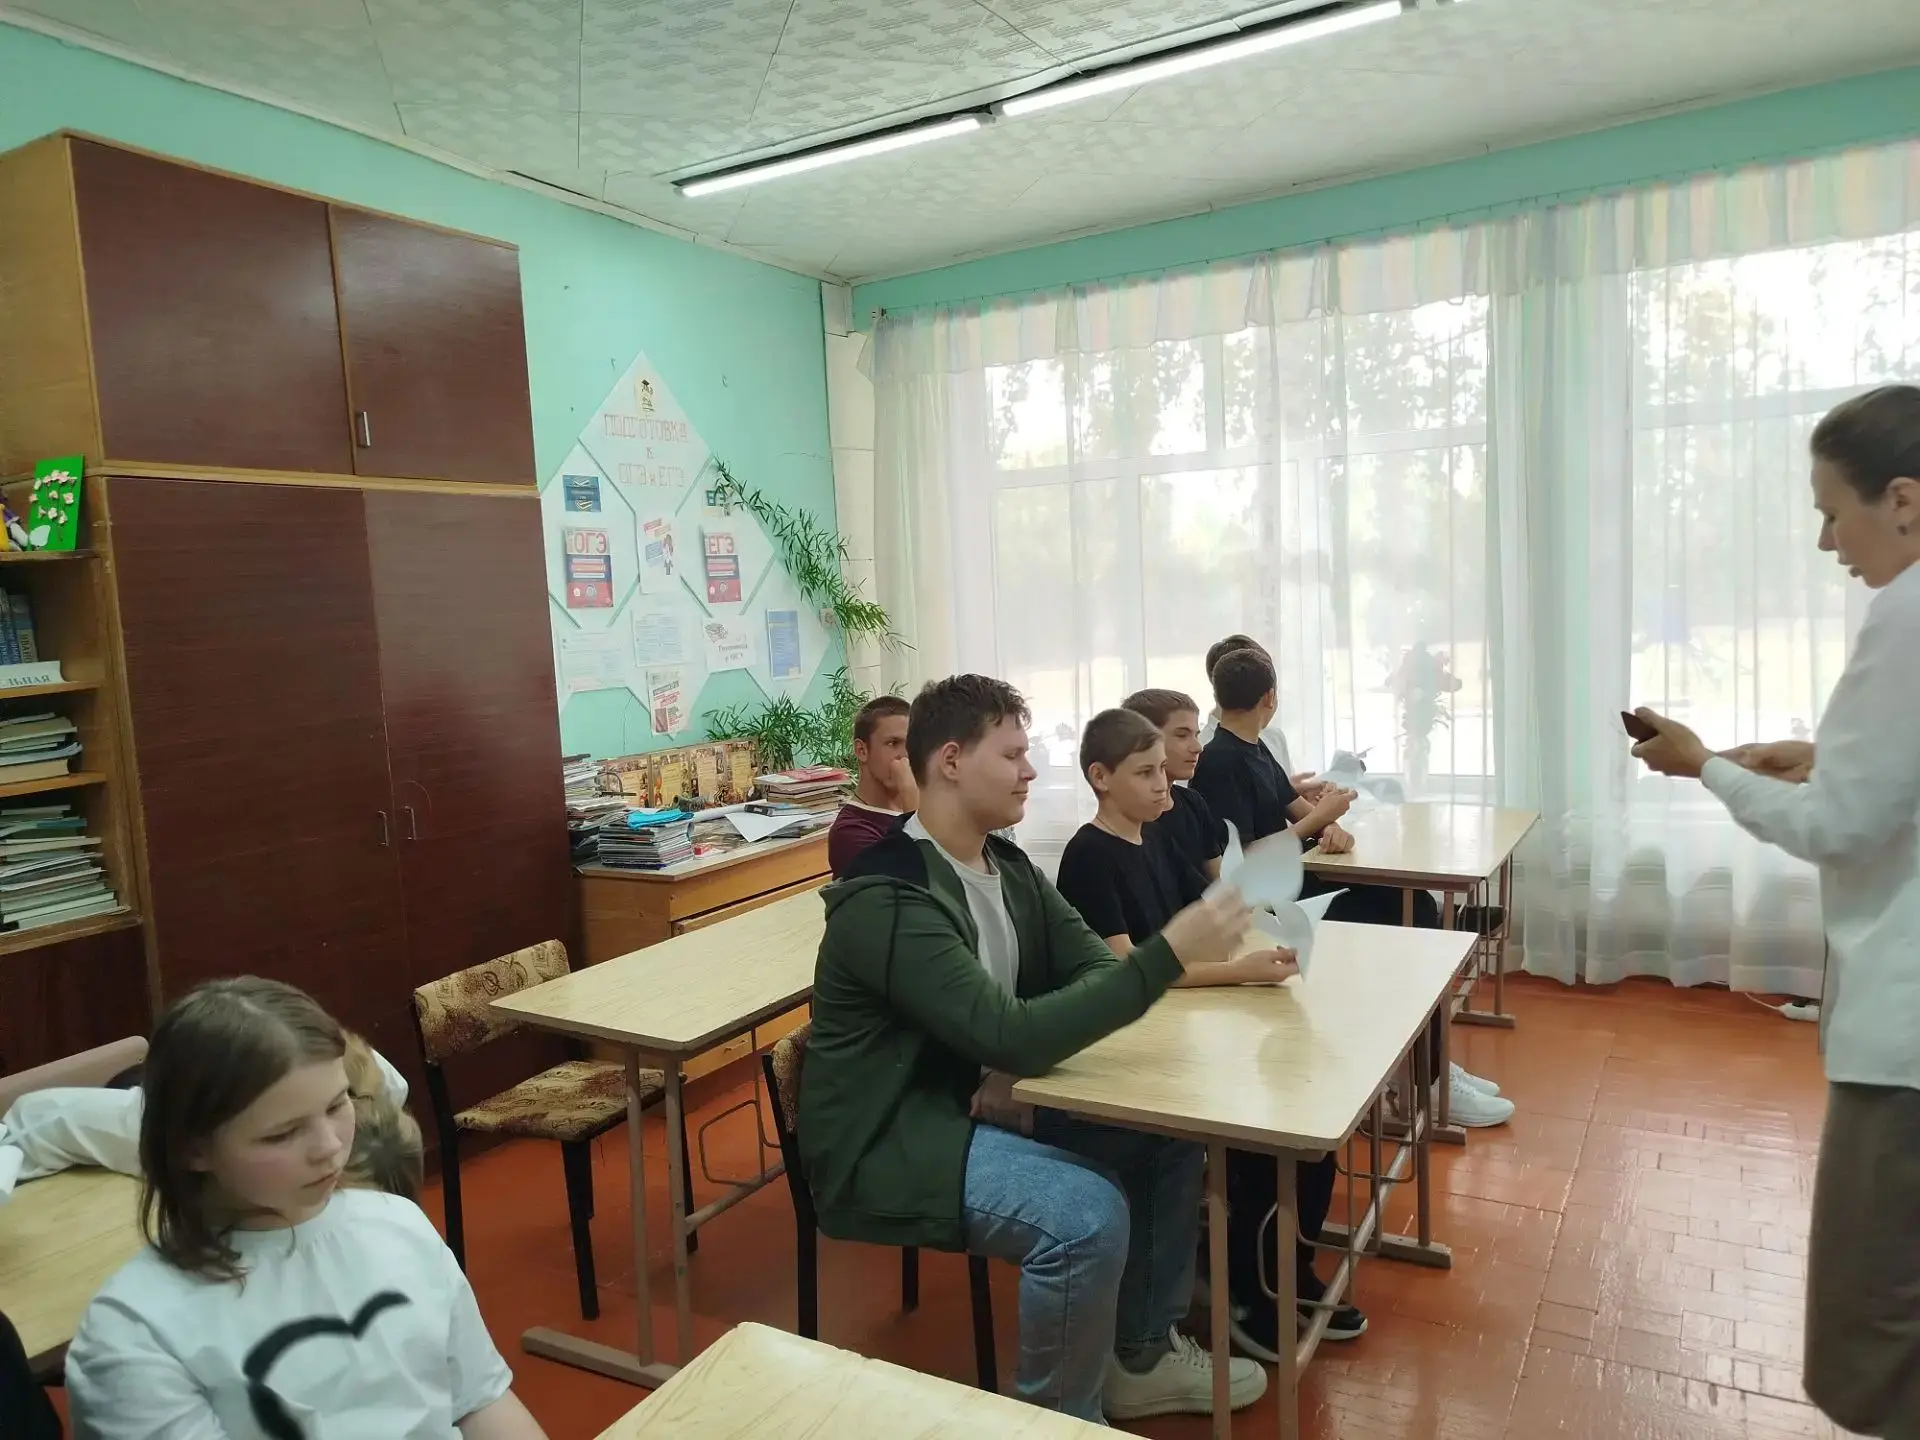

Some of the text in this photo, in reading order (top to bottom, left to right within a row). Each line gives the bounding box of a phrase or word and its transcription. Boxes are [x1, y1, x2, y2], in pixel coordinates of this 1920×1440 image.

[658, 466, 685, 487] ЕГЭ
[574, 531, 607, 553] ОГЭ
[709, 535, 735, 555] ЕГЭ
